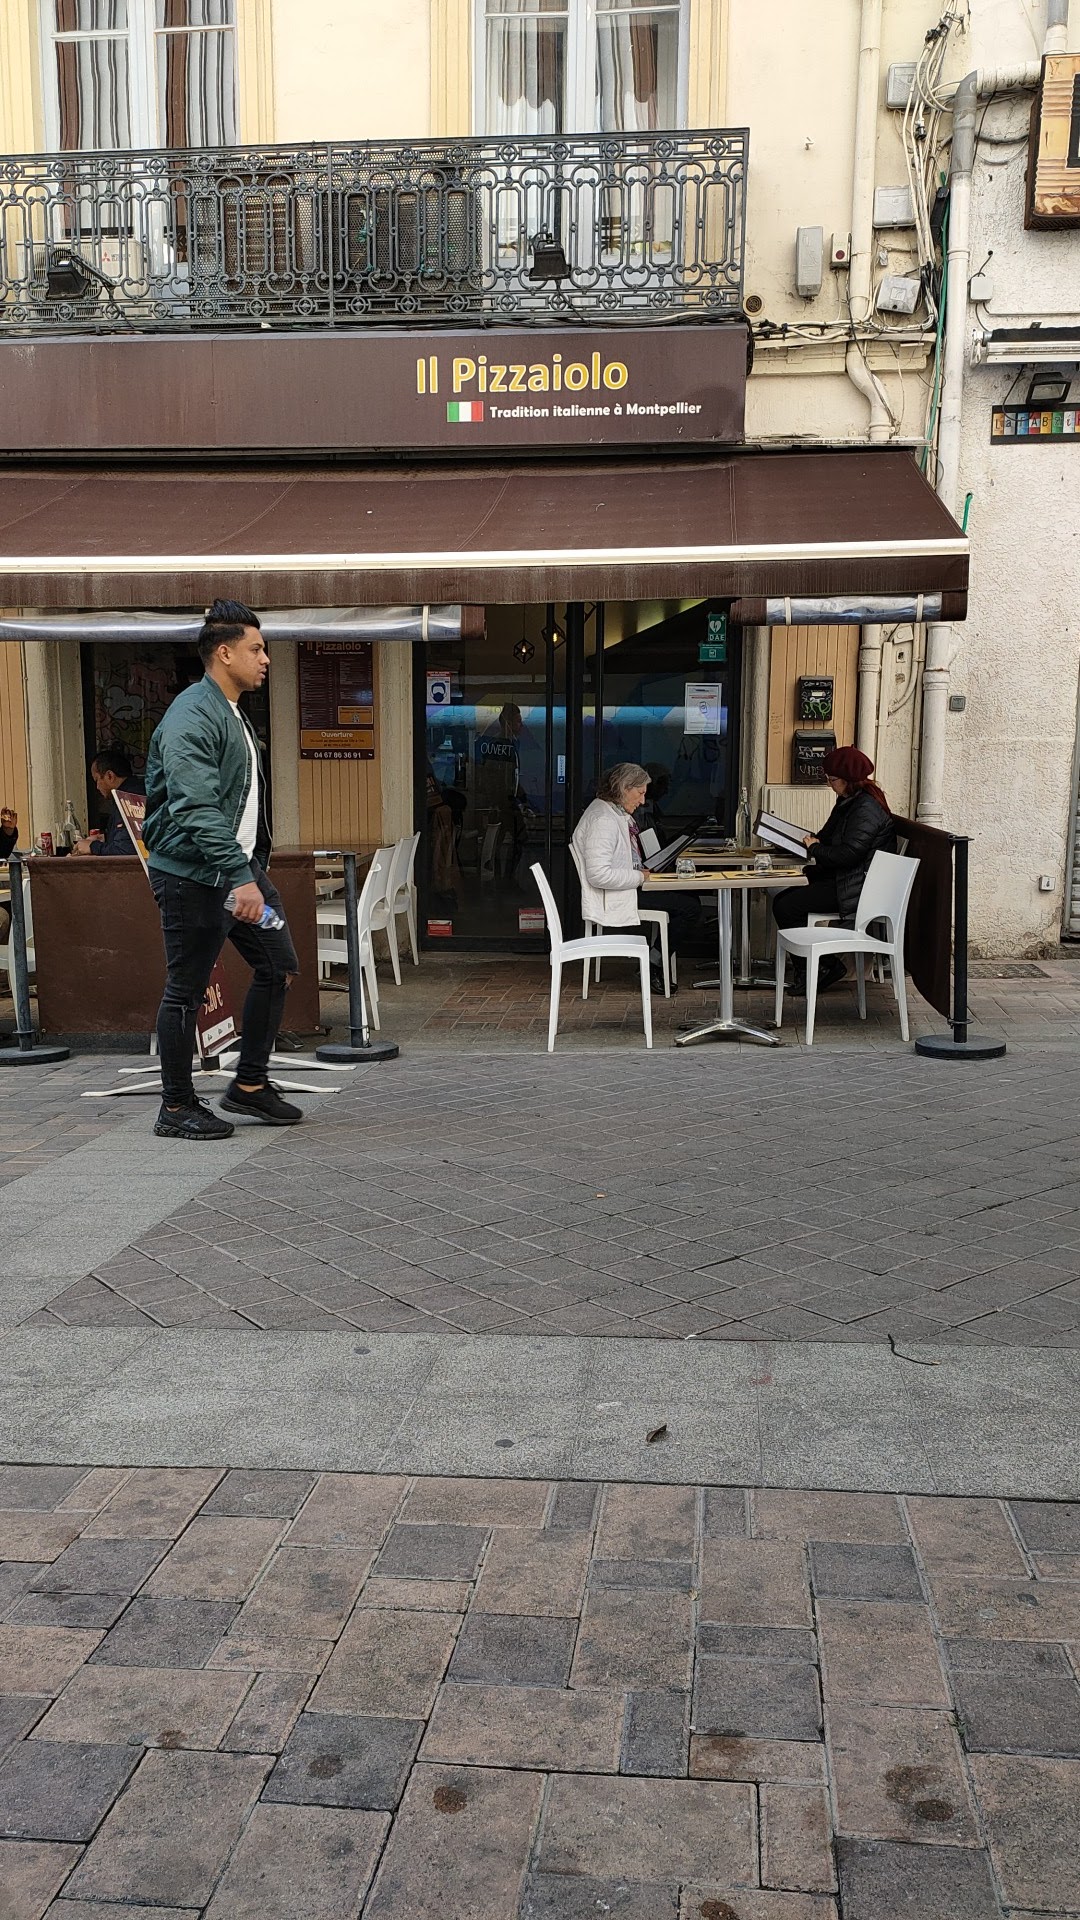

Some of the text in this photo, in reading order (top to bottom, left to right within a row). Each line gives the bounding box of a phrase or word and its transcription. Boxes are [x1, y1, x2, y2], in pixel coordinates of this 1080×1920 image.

[416, 351, 628, 393] Il Pizzaiolo
[490, 402, 701, 418] Tradition italienne à Montpellier
[314, 751, 323, 759] 04
[323, 751, 332, 759] 67
[352, 751, 361, 759] 91
[480, 742, 514, 757] OUVERT
